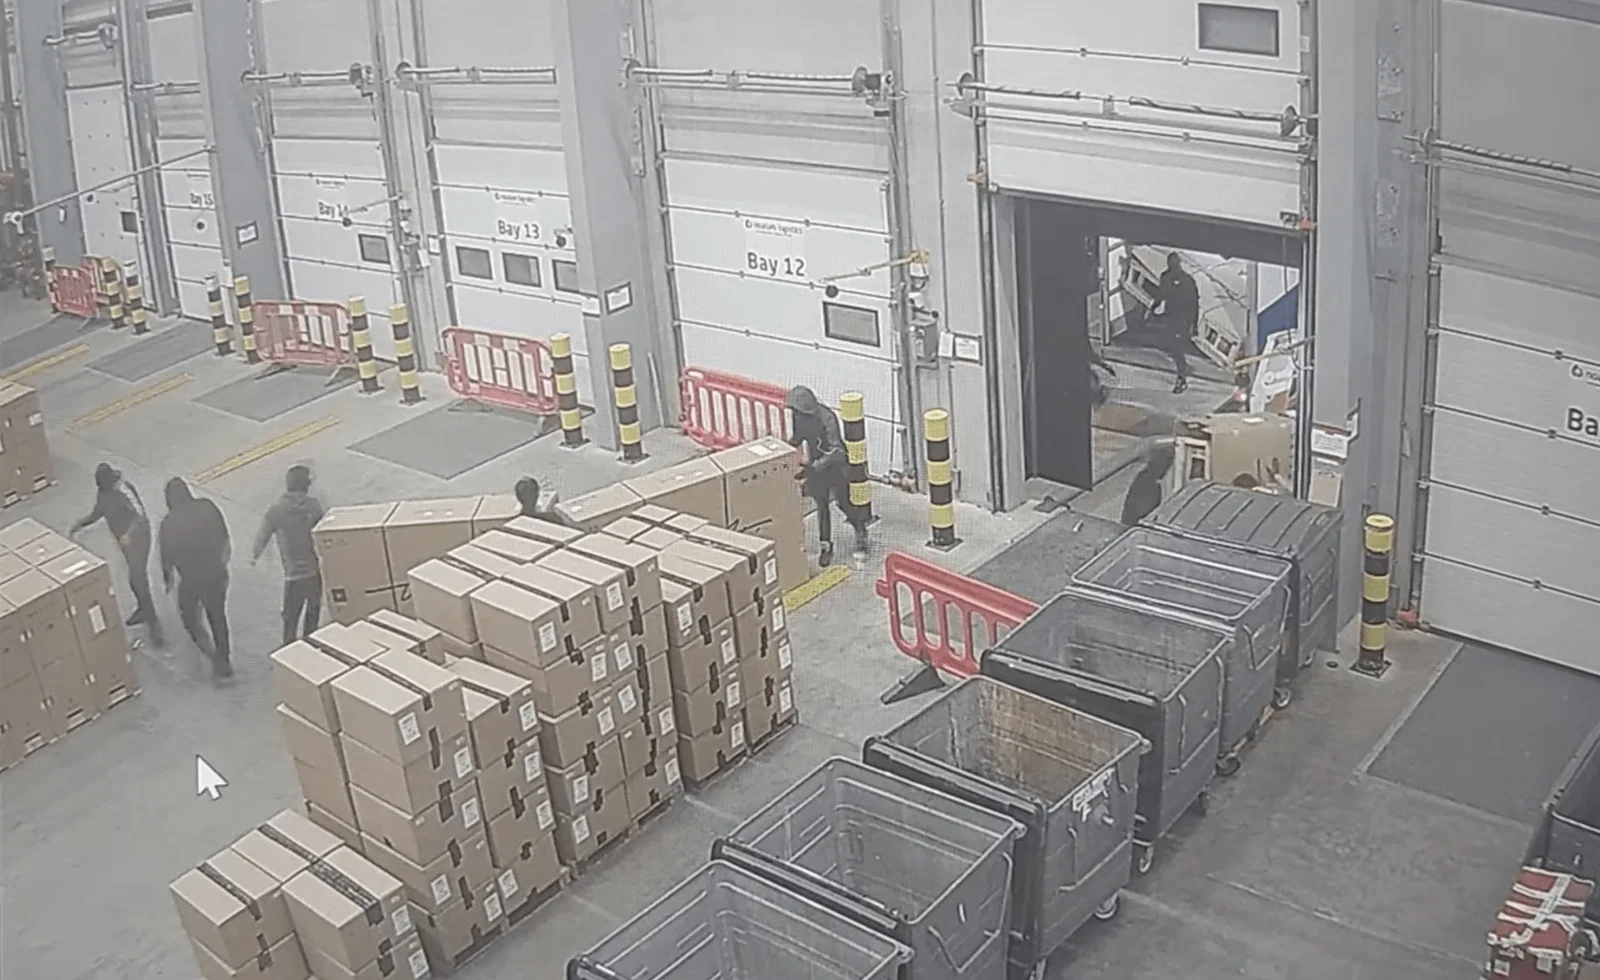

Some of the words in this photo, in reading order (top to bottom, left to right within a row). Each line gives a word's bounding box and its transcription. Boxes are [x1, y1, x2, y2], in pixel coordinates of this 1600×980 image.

[318, 201, 335, 219] Bay
[498, 219, 520, 240] Bay
[524, 222, 540, 240] 13
[747, 251, 778, 277] Bay
[784, 257, 805, 277] 12
